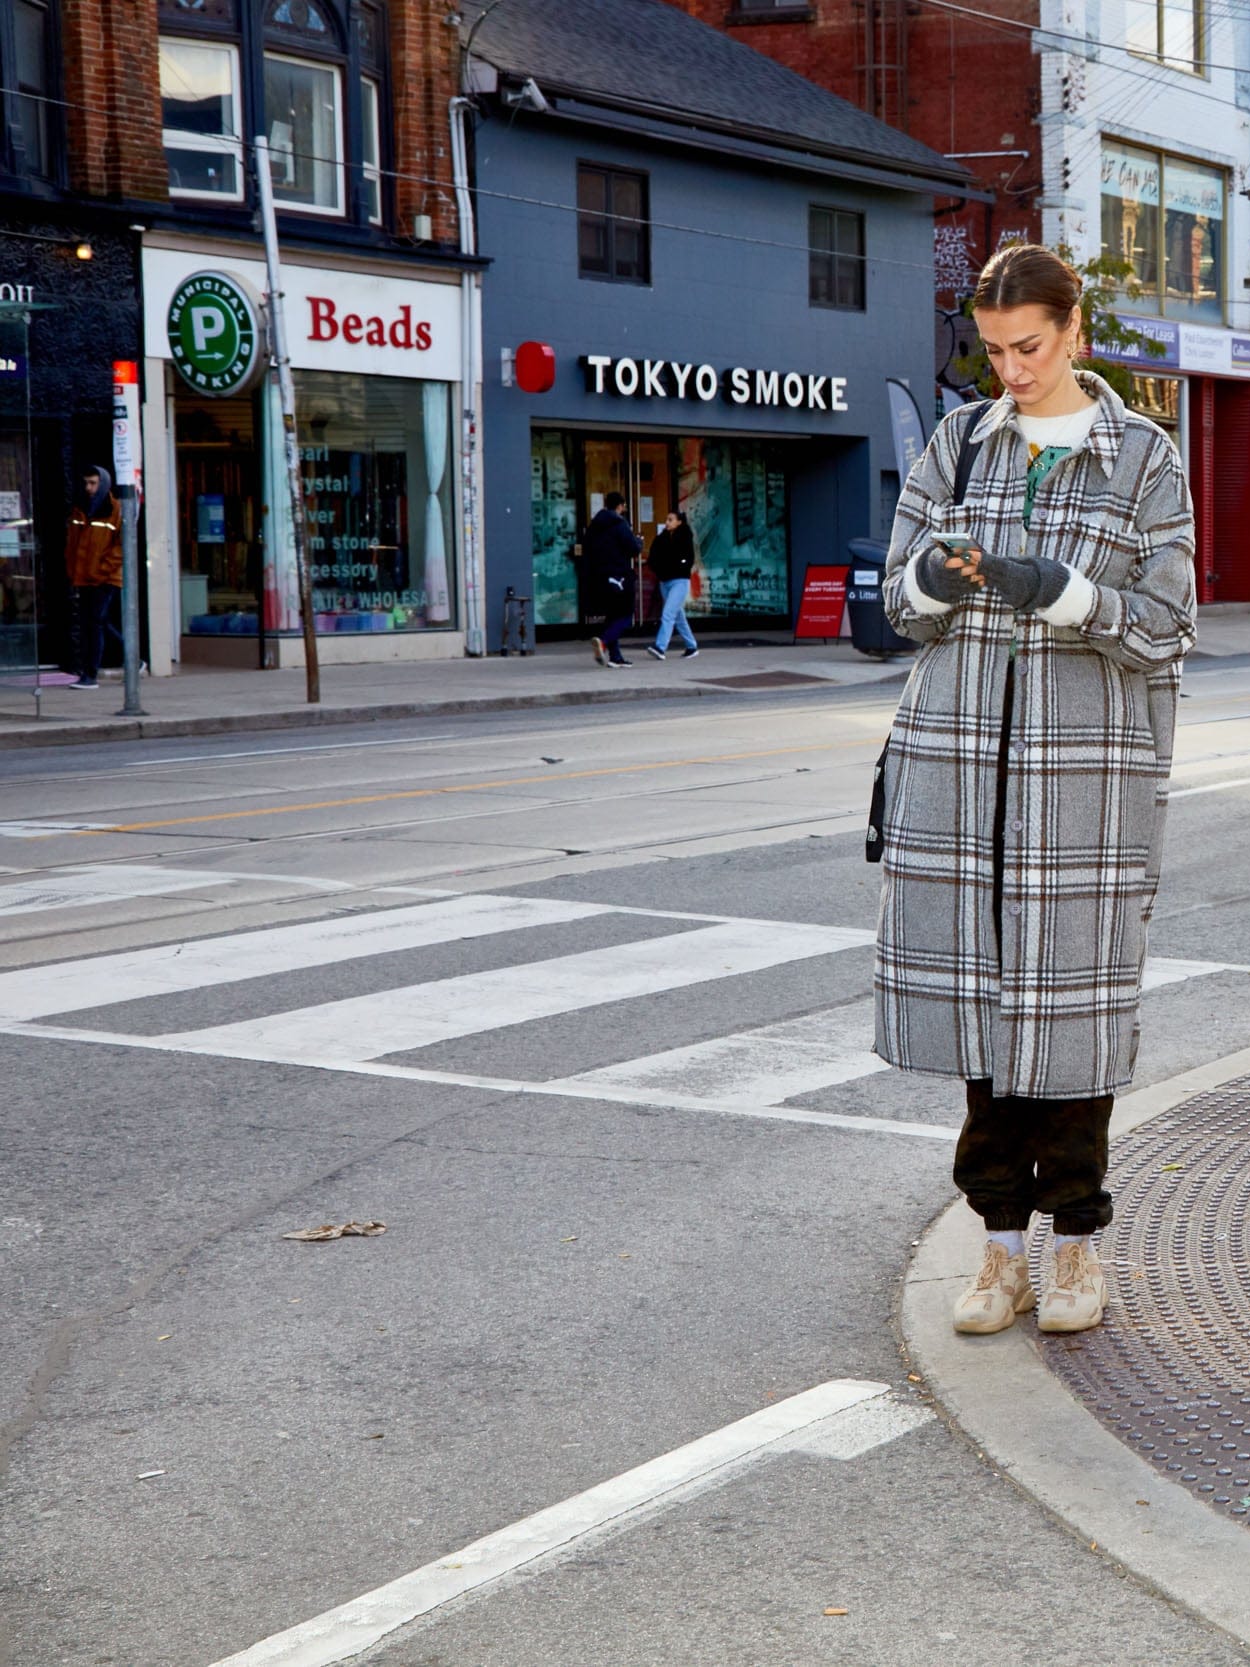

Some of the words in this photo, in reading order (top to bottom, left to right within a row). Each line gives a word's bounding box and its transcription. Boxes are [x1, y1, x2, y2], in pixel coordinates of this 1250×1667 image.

[171, 280, 246, 322] MUNICIPAL
[191, 306, 225, 351] P
[305, 296, 432, 351] Beads
[1155, 327, 1176, 344] Lease
[174, 343, 250, 388] PARKING
[588, 355, 718, 401] TOKYO
[731, 367, 849, 411] SMOKE
[332, 533, 379, 550] stone
[859, 590, 879, 600] Litter
